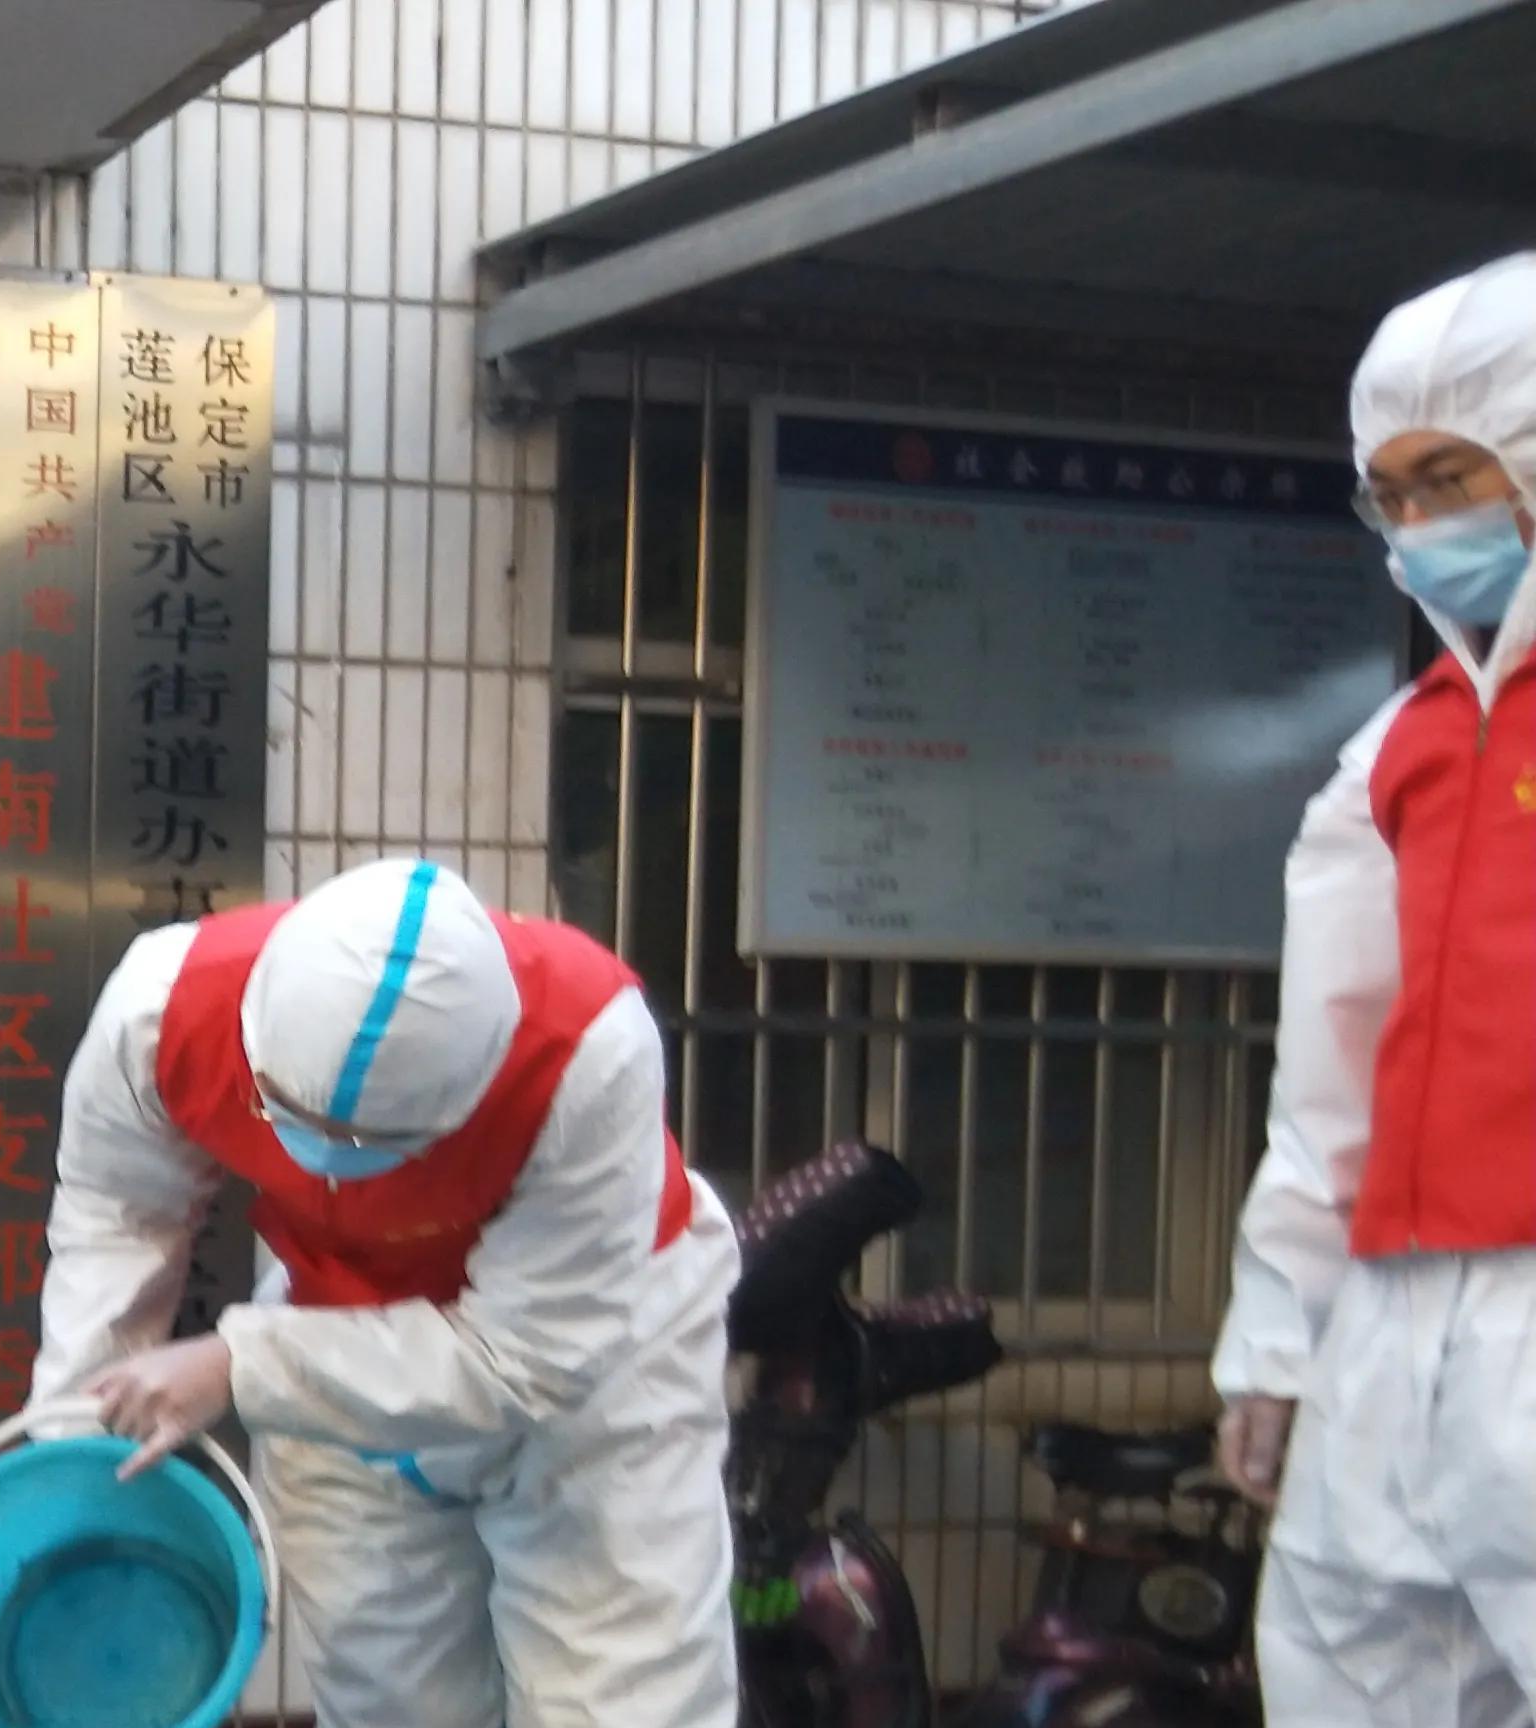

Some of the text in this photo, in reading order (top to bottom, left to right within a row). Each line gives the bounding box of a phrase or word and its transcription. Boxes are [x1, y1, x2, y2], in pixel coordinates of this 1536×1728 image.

[23, 322, 78, 635] 中国共产党
[121, 330, 177, 505] 莲池区
[198, 334, 252, 510] 保定市
